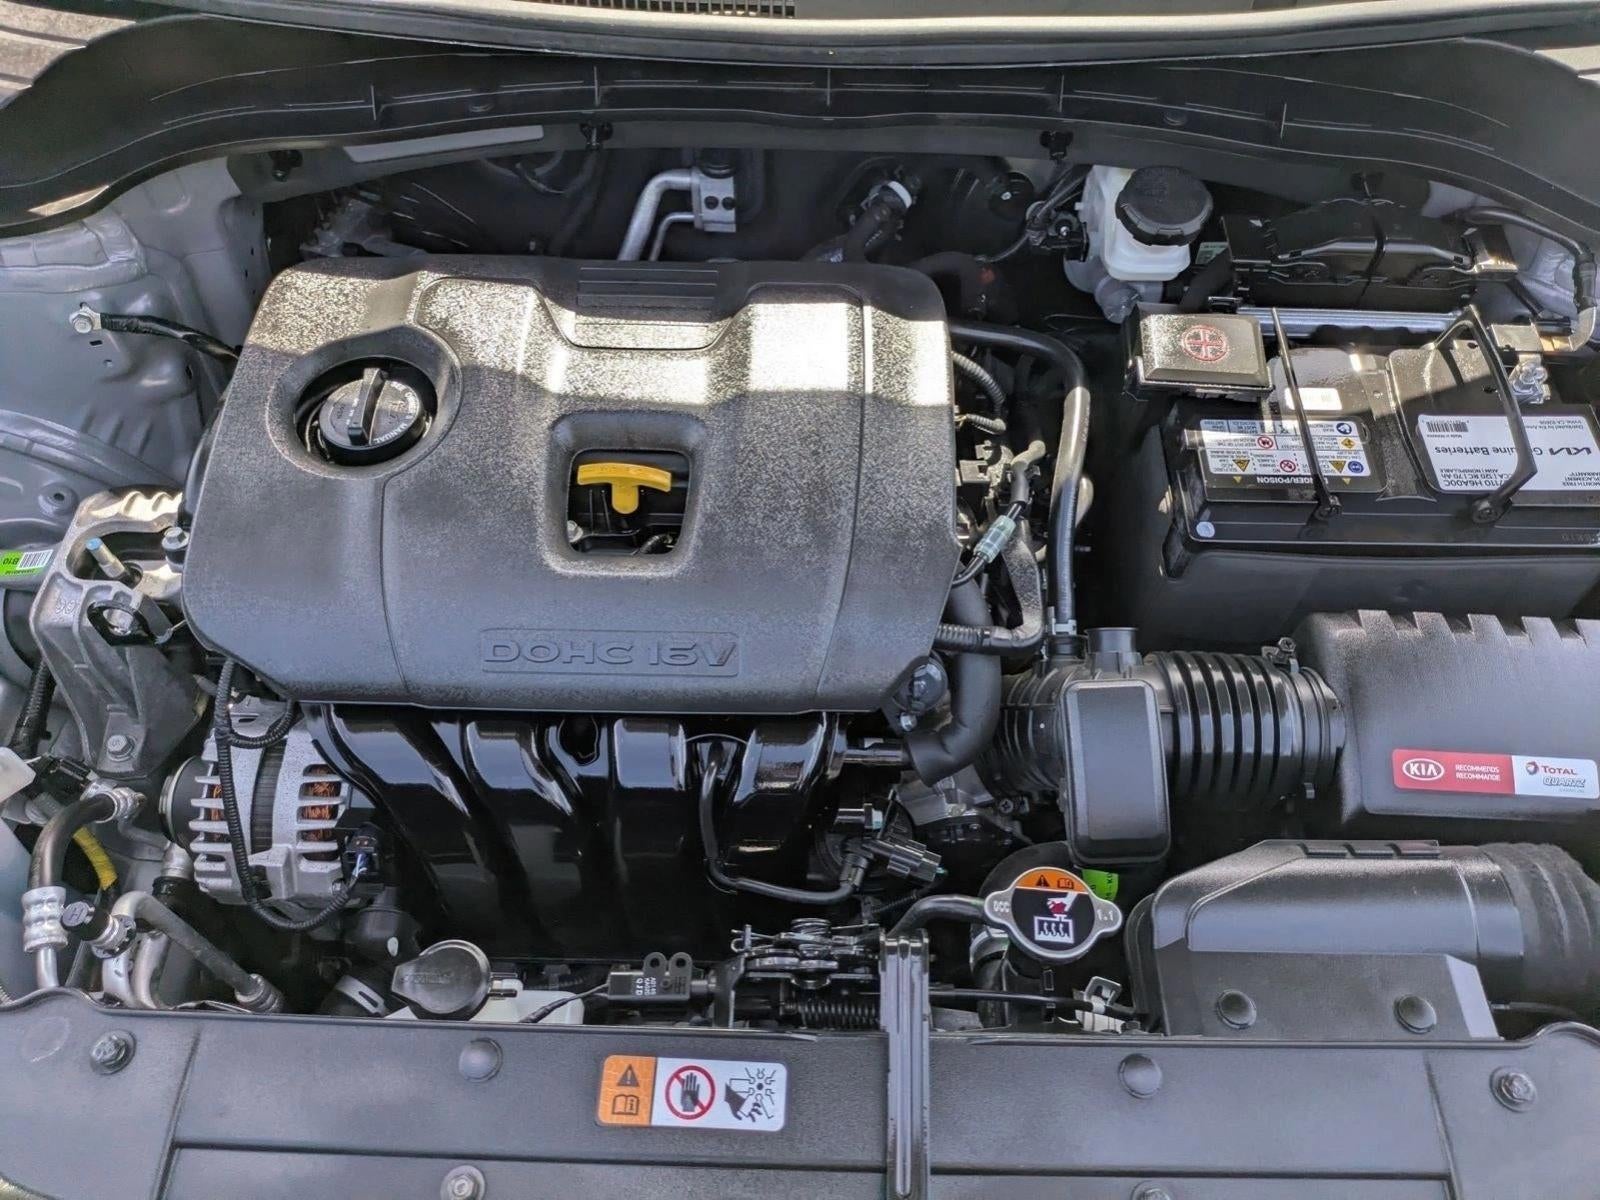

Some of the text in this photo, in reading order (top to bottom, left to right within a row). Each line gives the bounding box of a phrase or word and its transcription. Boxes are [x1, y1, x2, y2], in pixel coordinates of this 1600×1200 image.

[373, 423, 408, 444] MANUAL
[1434, 446, 1490, 456] Batteries
[2, 556, 20, 566] B10
[484, 639, 737, 668] DOHC 16V
[1409, 761, 1438, 777] KIA
[1455, 764, 1500, 774] RECOMMENDS
[1541, 765, 1578, 776] TOTAL
[1455, 772, 1501, 781] RECOMMANDE
[1542, 776, 1586, 788] QUARTZ
[1096, 909, 1114, 922] 1.1
